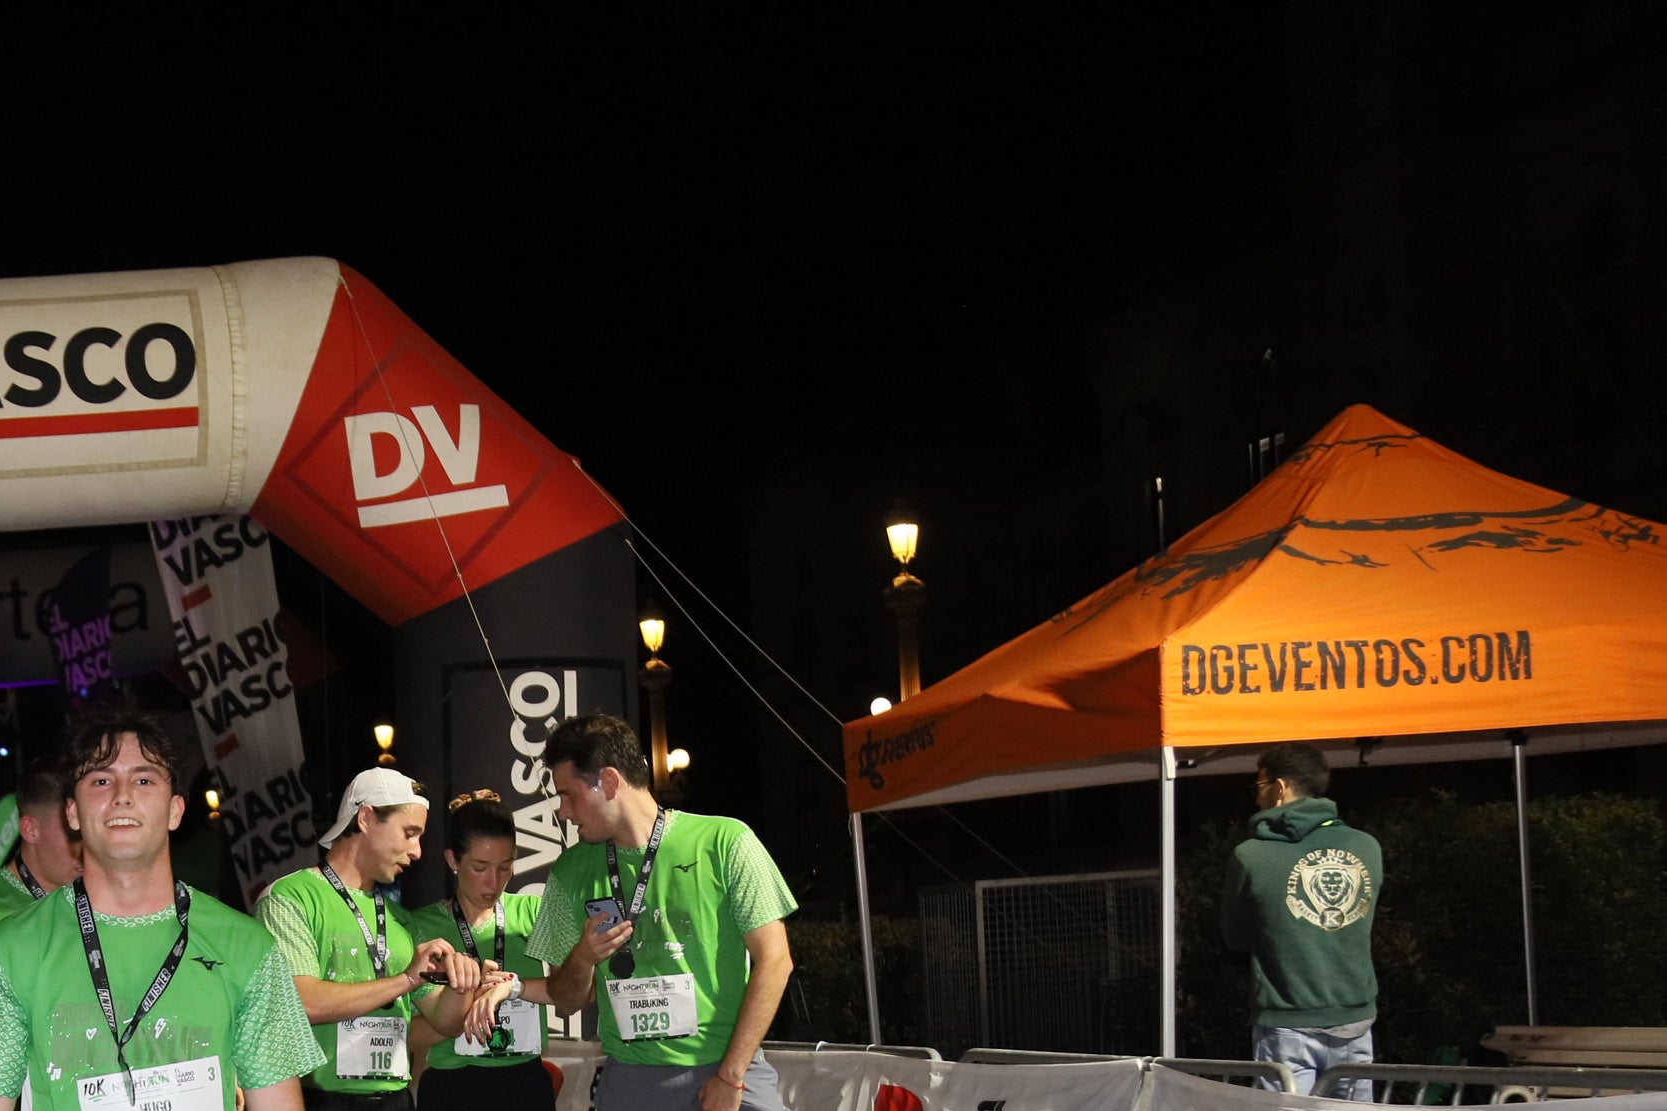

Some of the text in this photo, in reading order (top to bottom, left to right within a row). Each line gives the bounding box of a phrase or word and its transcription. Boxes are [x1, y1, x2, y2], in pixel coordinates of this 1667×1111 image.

[344, 403, 481, 502] DV
[1182, 630, 1532, 696] DGEVENTOS.COM
[509, 670, 564, 876] VASCO
[1287, 858, 1308, 894] KINGS
[1306, 850, 1322, 862] OF
[1325, 911, 1341, 927] K
[141, 968, 171, 1012] FINISHER
[629, 998, 669, 1009] TRABUKING
[630, 1011, 670, 1032] 1329
[370, 1037, 394, 1047] ADOLFO
[370, 1051, 392, 1070] 116
[208, 1067, 216, 1081] 3
[84, 1079, 105, 1097] 10K
